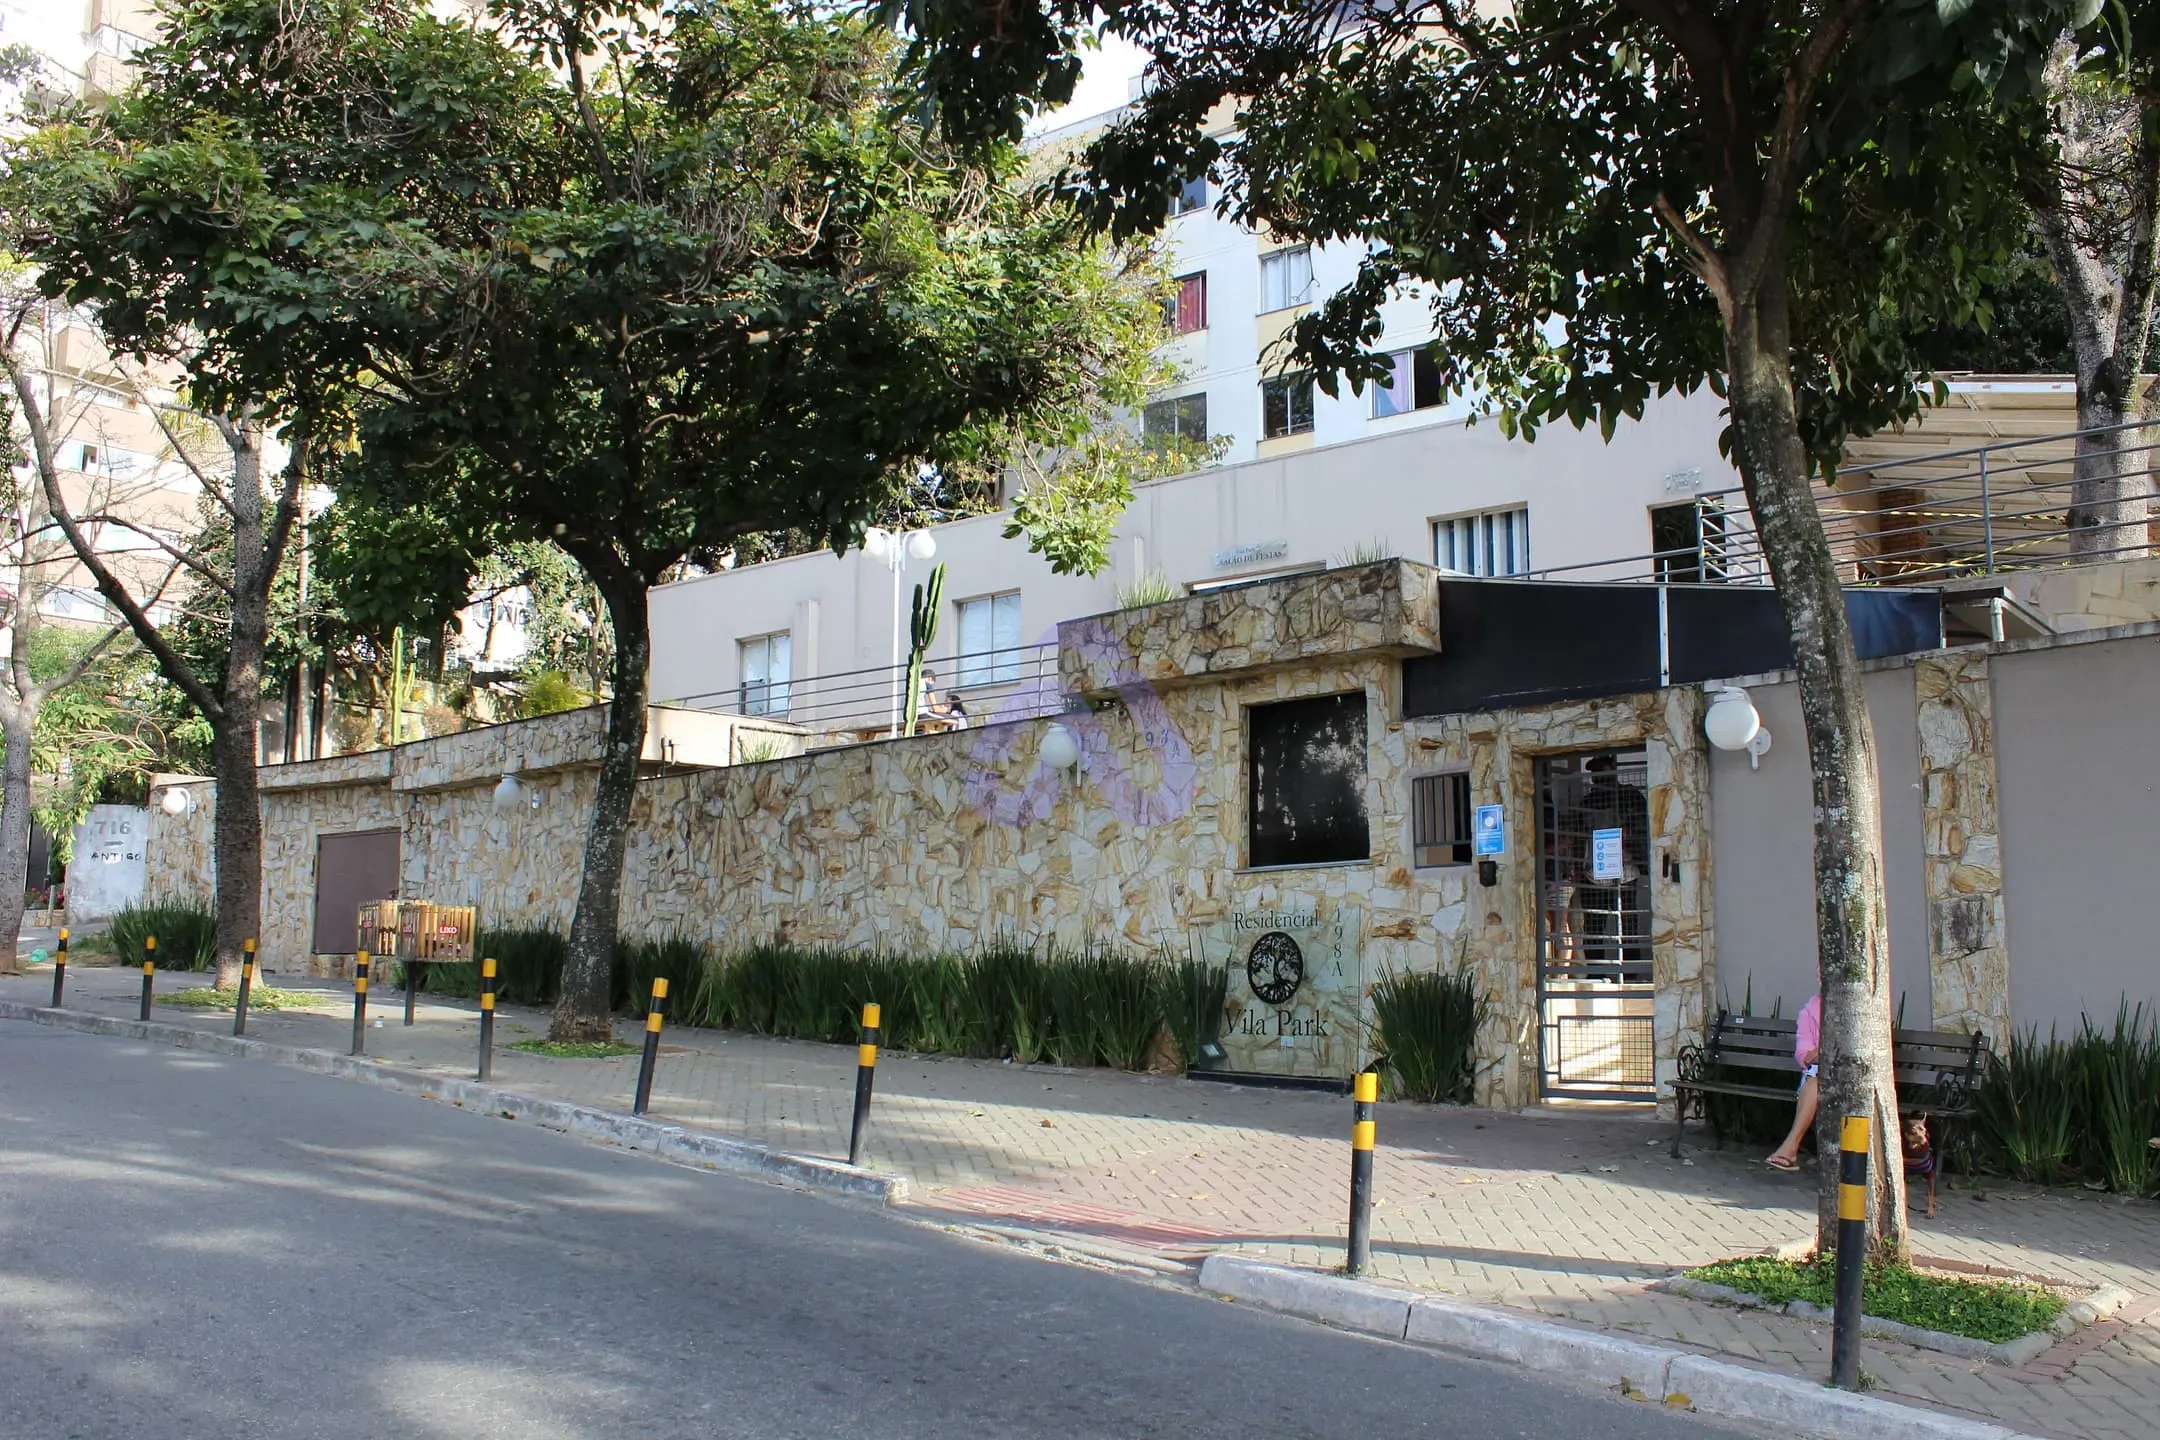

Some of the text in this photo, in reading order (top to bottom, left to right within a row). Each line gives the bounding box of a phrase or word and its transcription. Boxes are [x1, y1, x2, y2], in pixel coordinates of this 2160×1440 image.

[94, 821, 131, 835] 716
[91, 852, 141, 861] ANTIGO
[1234, 909, 1319, 930] Residencial
[439, 926, 457, 934] LIXO
[1225, 1008, 1329, 1036] Vila Park
